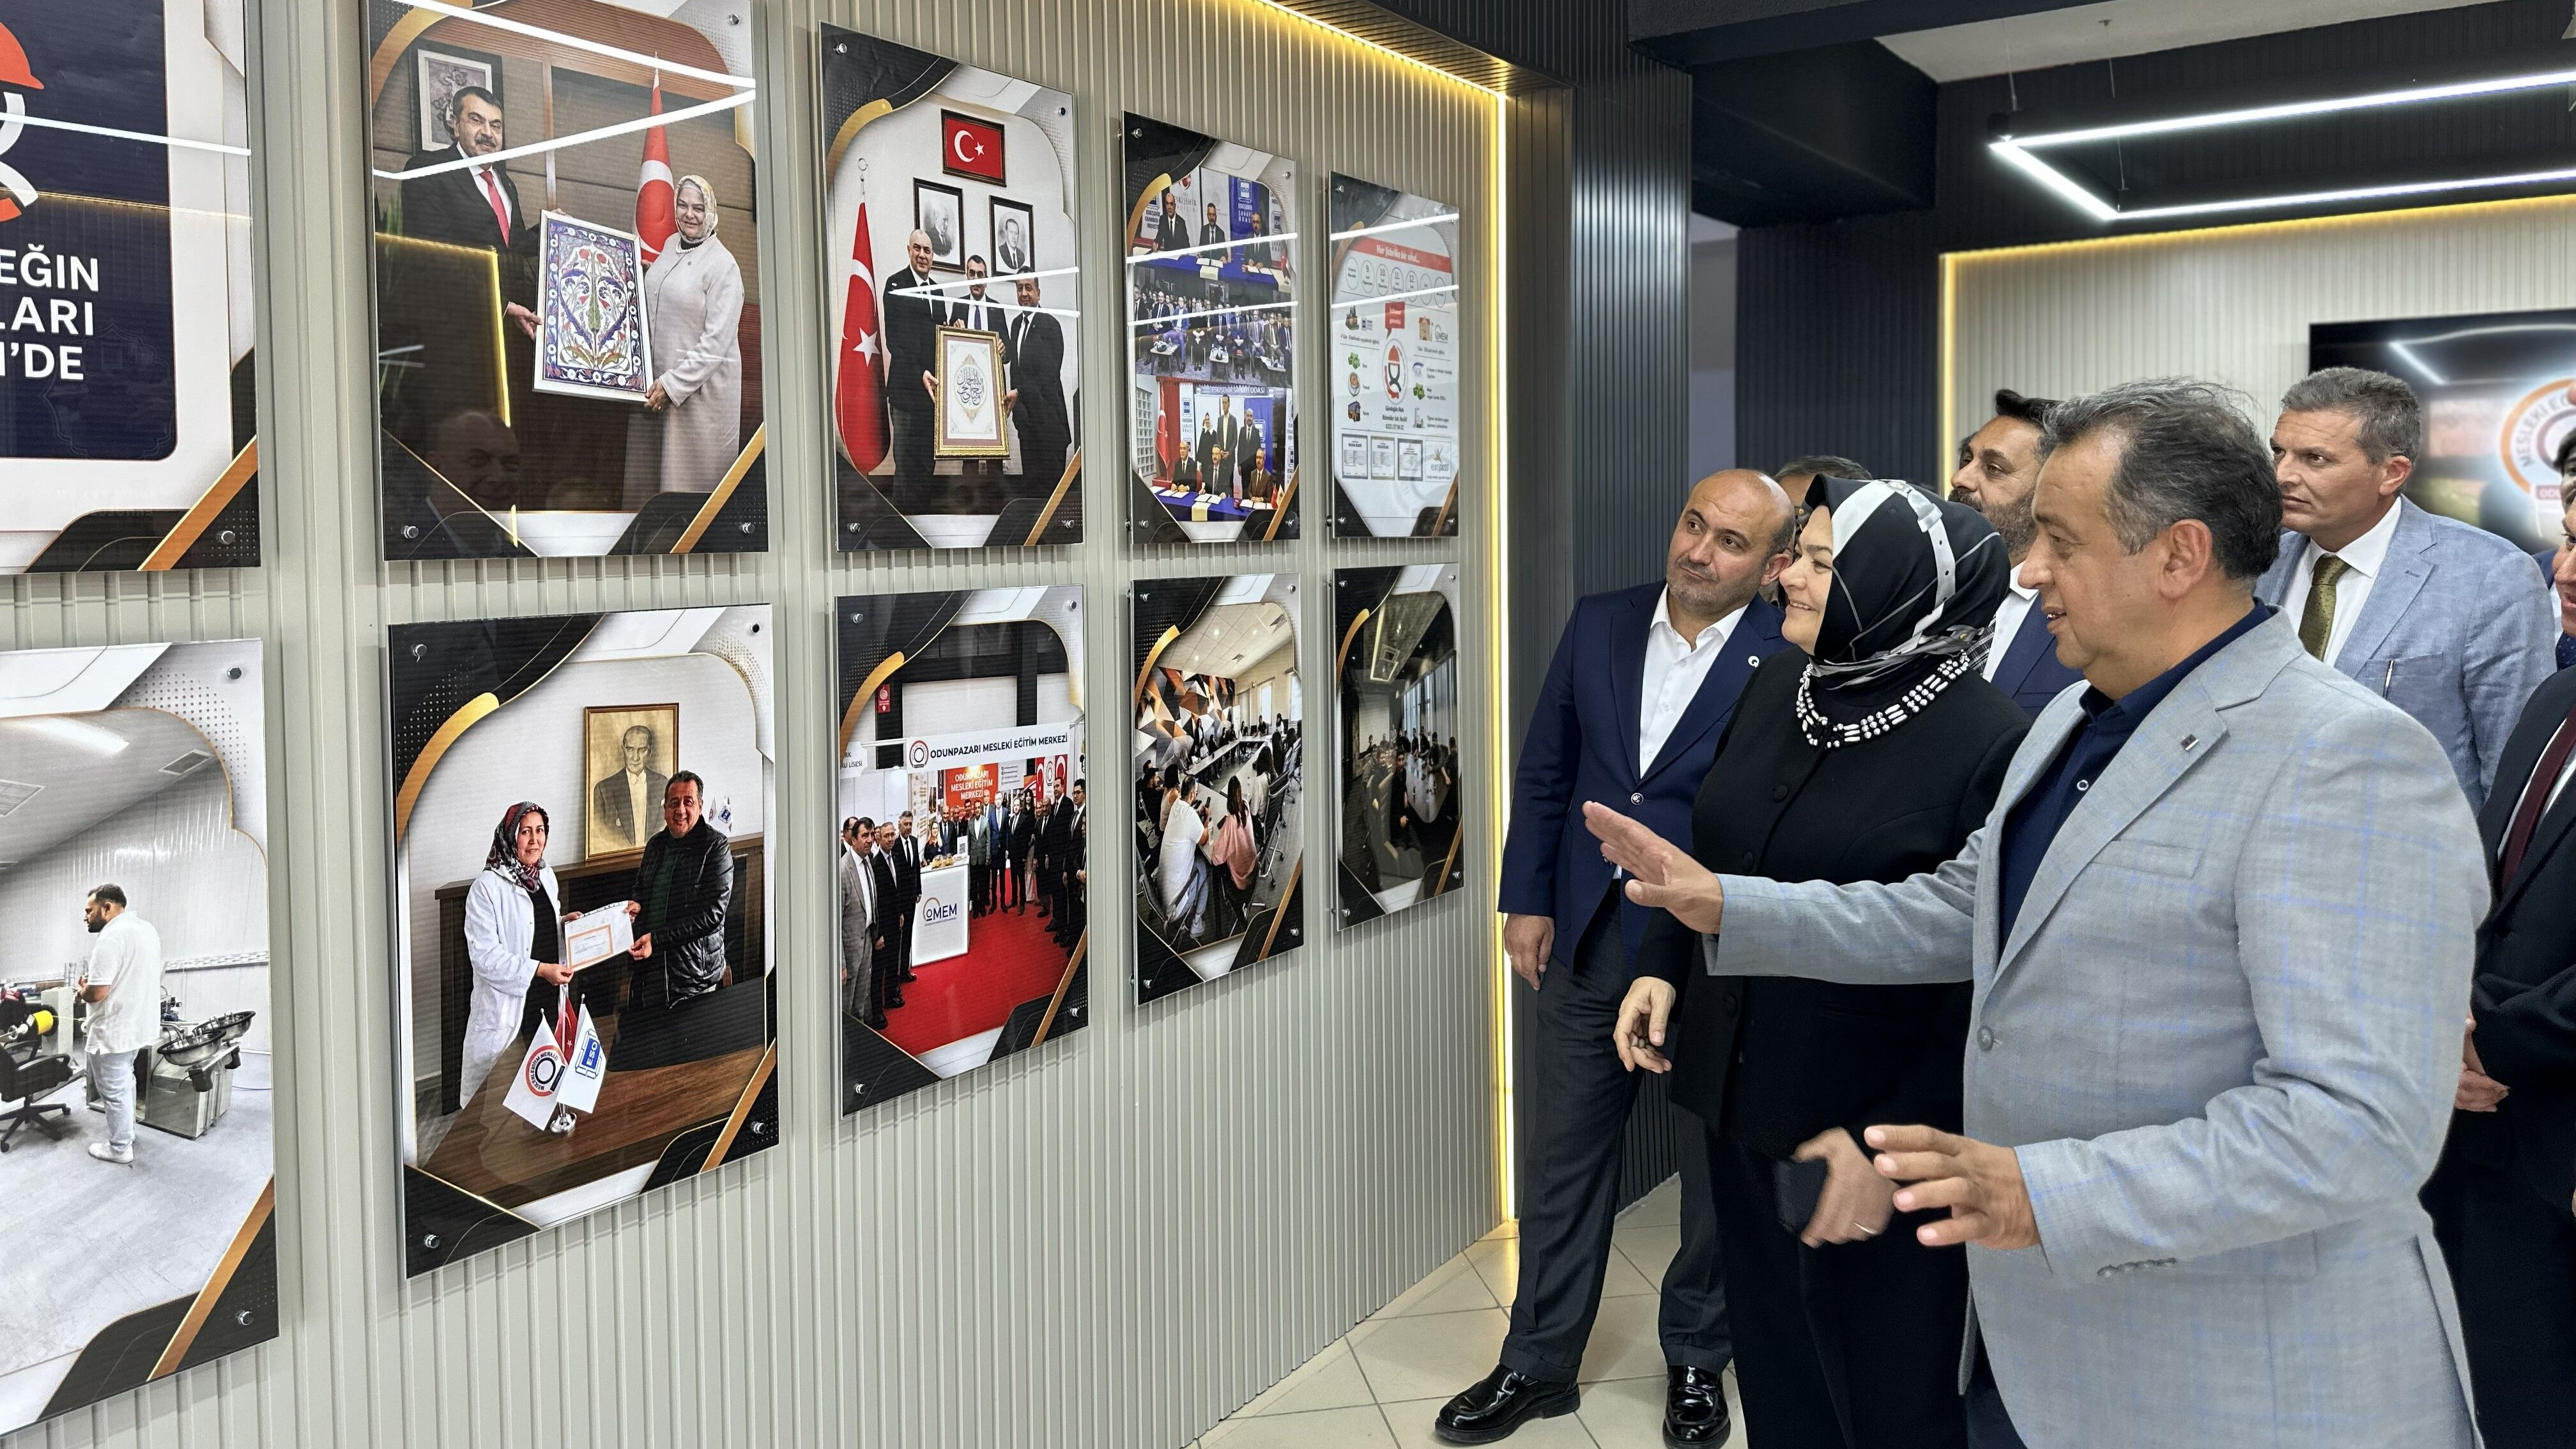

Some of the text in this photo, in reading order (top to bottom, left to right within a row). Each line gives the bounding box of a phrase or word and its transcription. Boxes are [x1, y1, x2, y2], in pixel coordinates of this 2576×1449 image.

[930, 744, 981, 758] ODUNPAZARI
[983, 739, 1013, 753] MESLEKİ
[1014, 736, 1037, 748] EĞİTİM
[1038, 732, 1068, 745] MERKEZİ
[951, 780, 974, 792] MESLEKİ
[586, 1041, 598, 1066] ESO
